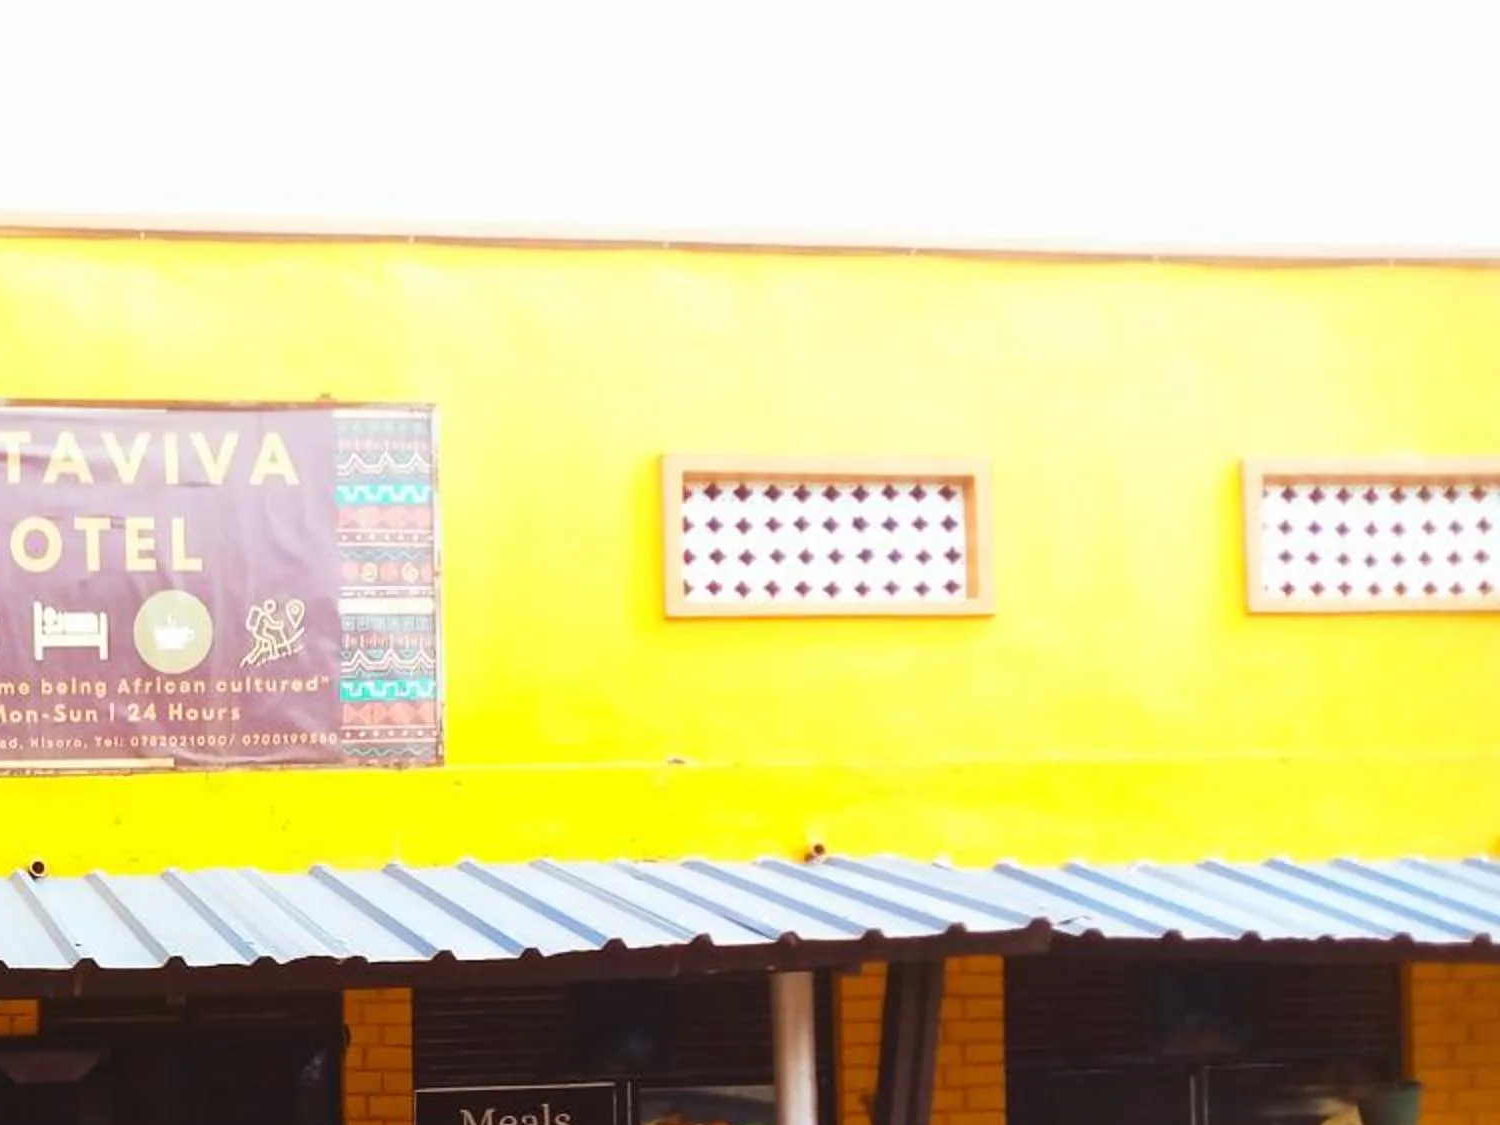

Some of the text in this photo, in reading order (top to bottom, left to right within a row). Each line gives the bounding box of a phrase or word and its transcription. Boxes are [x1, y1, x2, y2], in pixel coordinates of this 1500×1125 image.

[41, 677, 108, 698] being
[117, 676, 206, 696] African
[127, 704, 158, 722] 24
[169, 702, 242, 722] Hours
